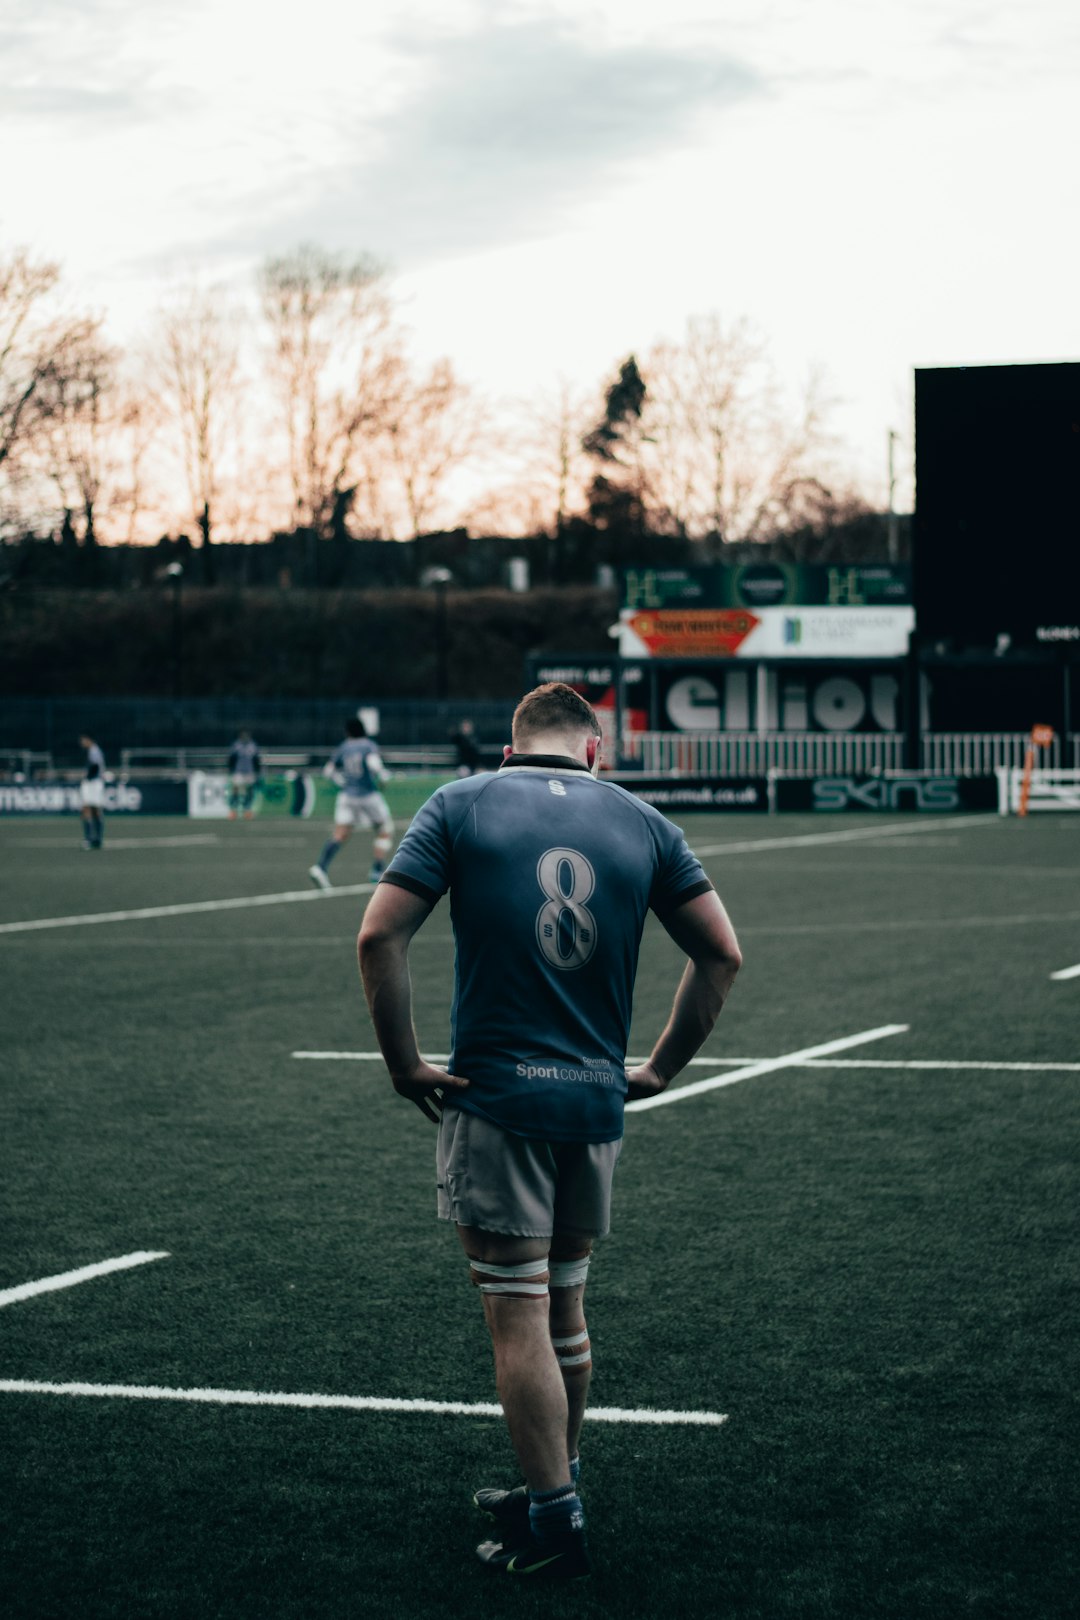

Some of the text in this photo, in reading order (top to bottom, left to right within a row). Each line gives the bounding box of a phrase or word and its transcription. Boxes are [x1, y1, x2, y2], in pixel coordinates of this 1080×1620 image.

[535, 847, 598, 971] 8
[516, 1063, 615, 1085] Sport COVENTRY
